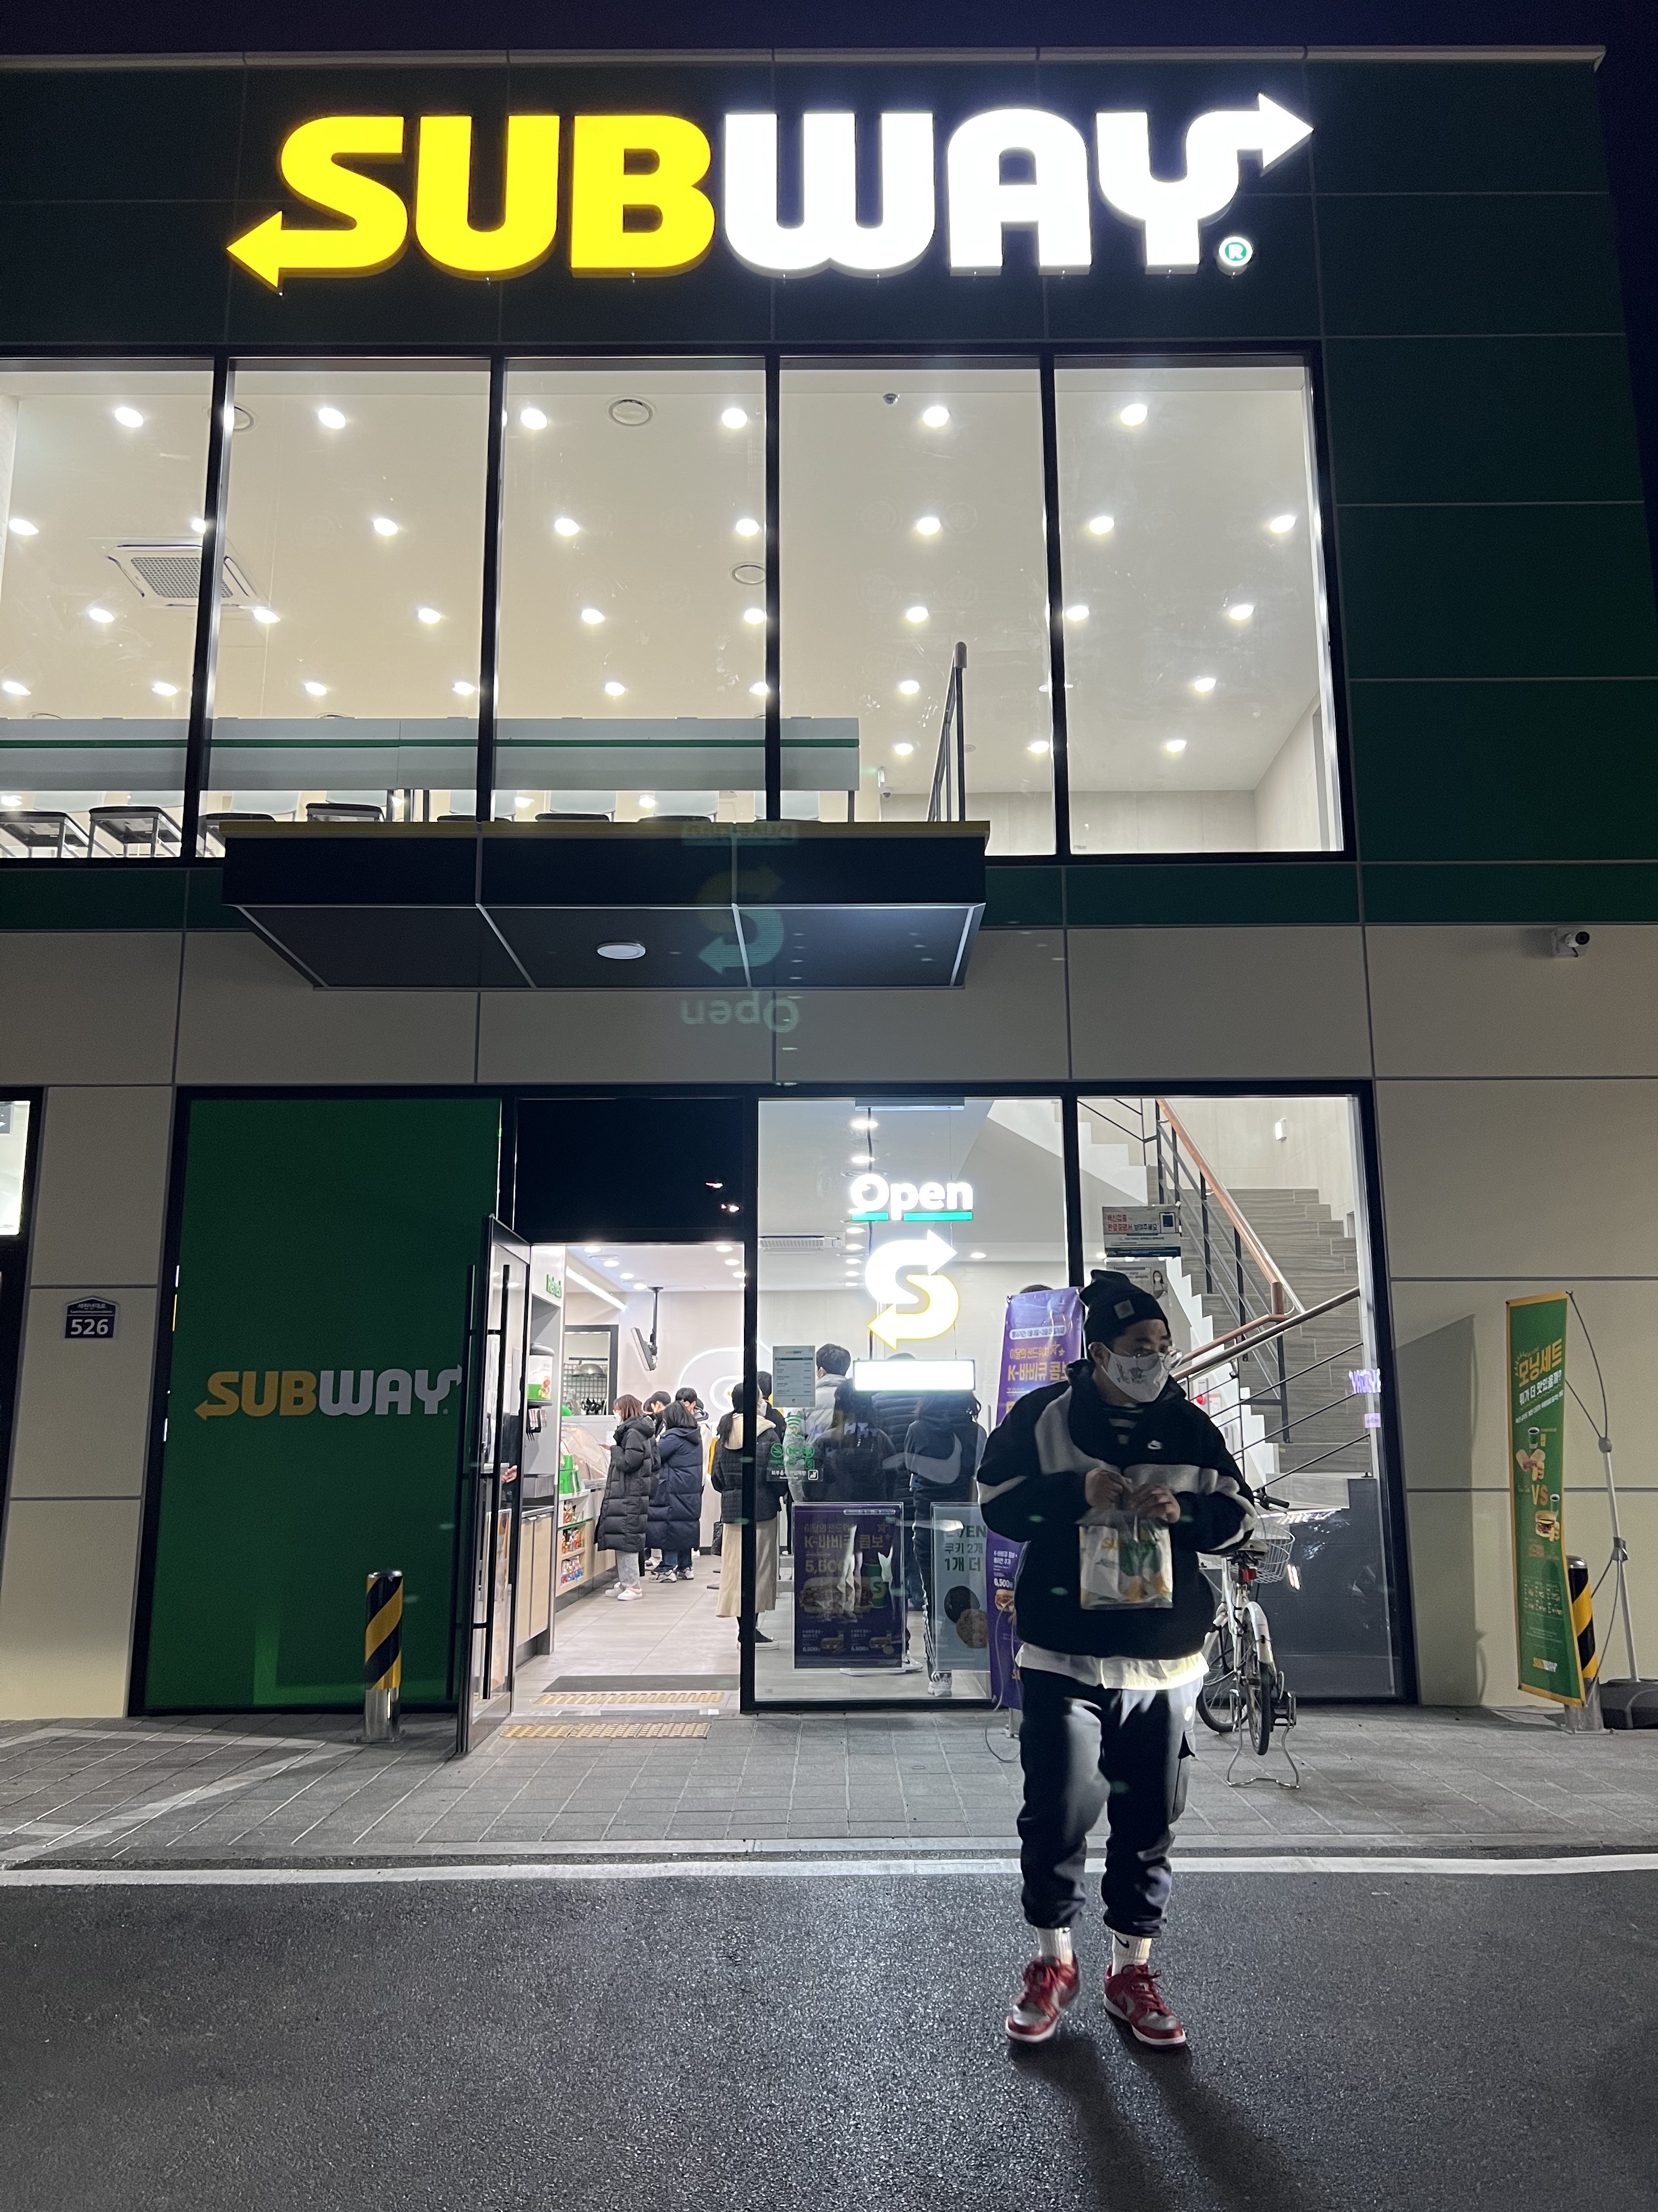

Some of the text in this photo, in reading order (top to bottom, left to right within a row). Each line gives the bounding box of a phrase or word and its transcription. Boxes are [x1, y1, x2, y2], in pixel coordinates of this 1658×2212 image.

[227, 93, 1314, 288] SUBWAY
[849, 1173, 973, 1221] Open
[70, 1319, 109, 1335] 526
[1519, 1338, 1563, 1387] 모닝세트
[1007, 1362, 1047, 1382] K-바비큐
[194, 1364, 463, 1421] SUBWAY
[1530, 1384, 1536, 1398] 더
[1531, 1484, 1548, 1506] VS
[804, 1523, 826, 1533] 이달의
[859, 1534, 884, 1549] 콤보
[945, 1543, 983, 1554] 쿠키 2개
[945, 1557, 965, 1572] 1개
[969, 1557, 981, 1572] 더
